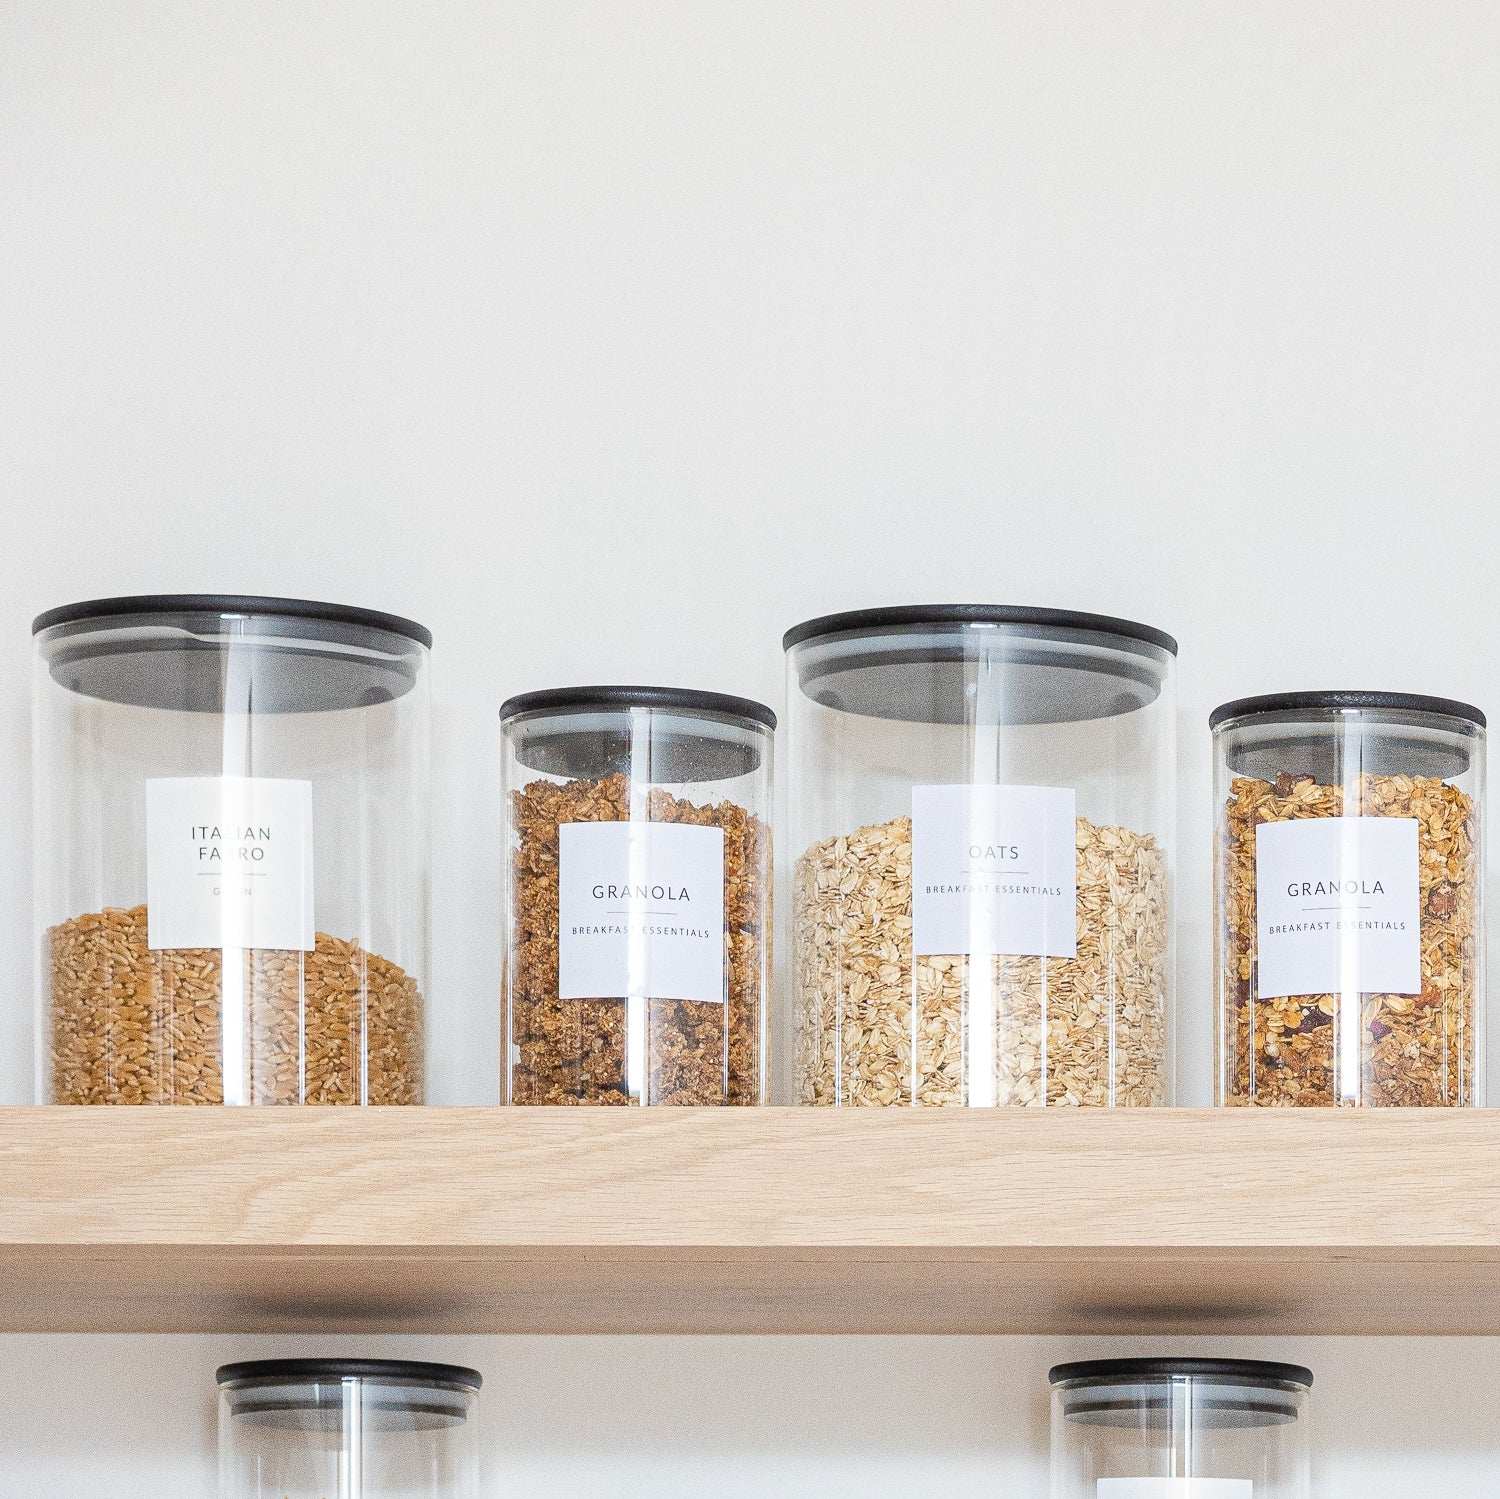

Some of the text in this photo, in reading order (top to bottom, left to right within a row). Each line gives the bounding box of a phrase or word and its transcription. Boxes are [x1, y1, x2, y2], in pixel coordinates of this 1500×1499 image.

[191, 824, 271, 841] ITAIAN
[199, 846, 265, 862] FARO
[968, 845, 1020, 860] OATS
[591, 882, 691, 902] GRANOLA
[925, 882, 1062, 897] BREAKFAT ESSENTIALS
[1287, 880, 1385, 898] GRANOLA
[571, 924, 710, 940] BREAKFAS ESSENTIALS
[1268, 919, 1331, 936] BREAKFAST
